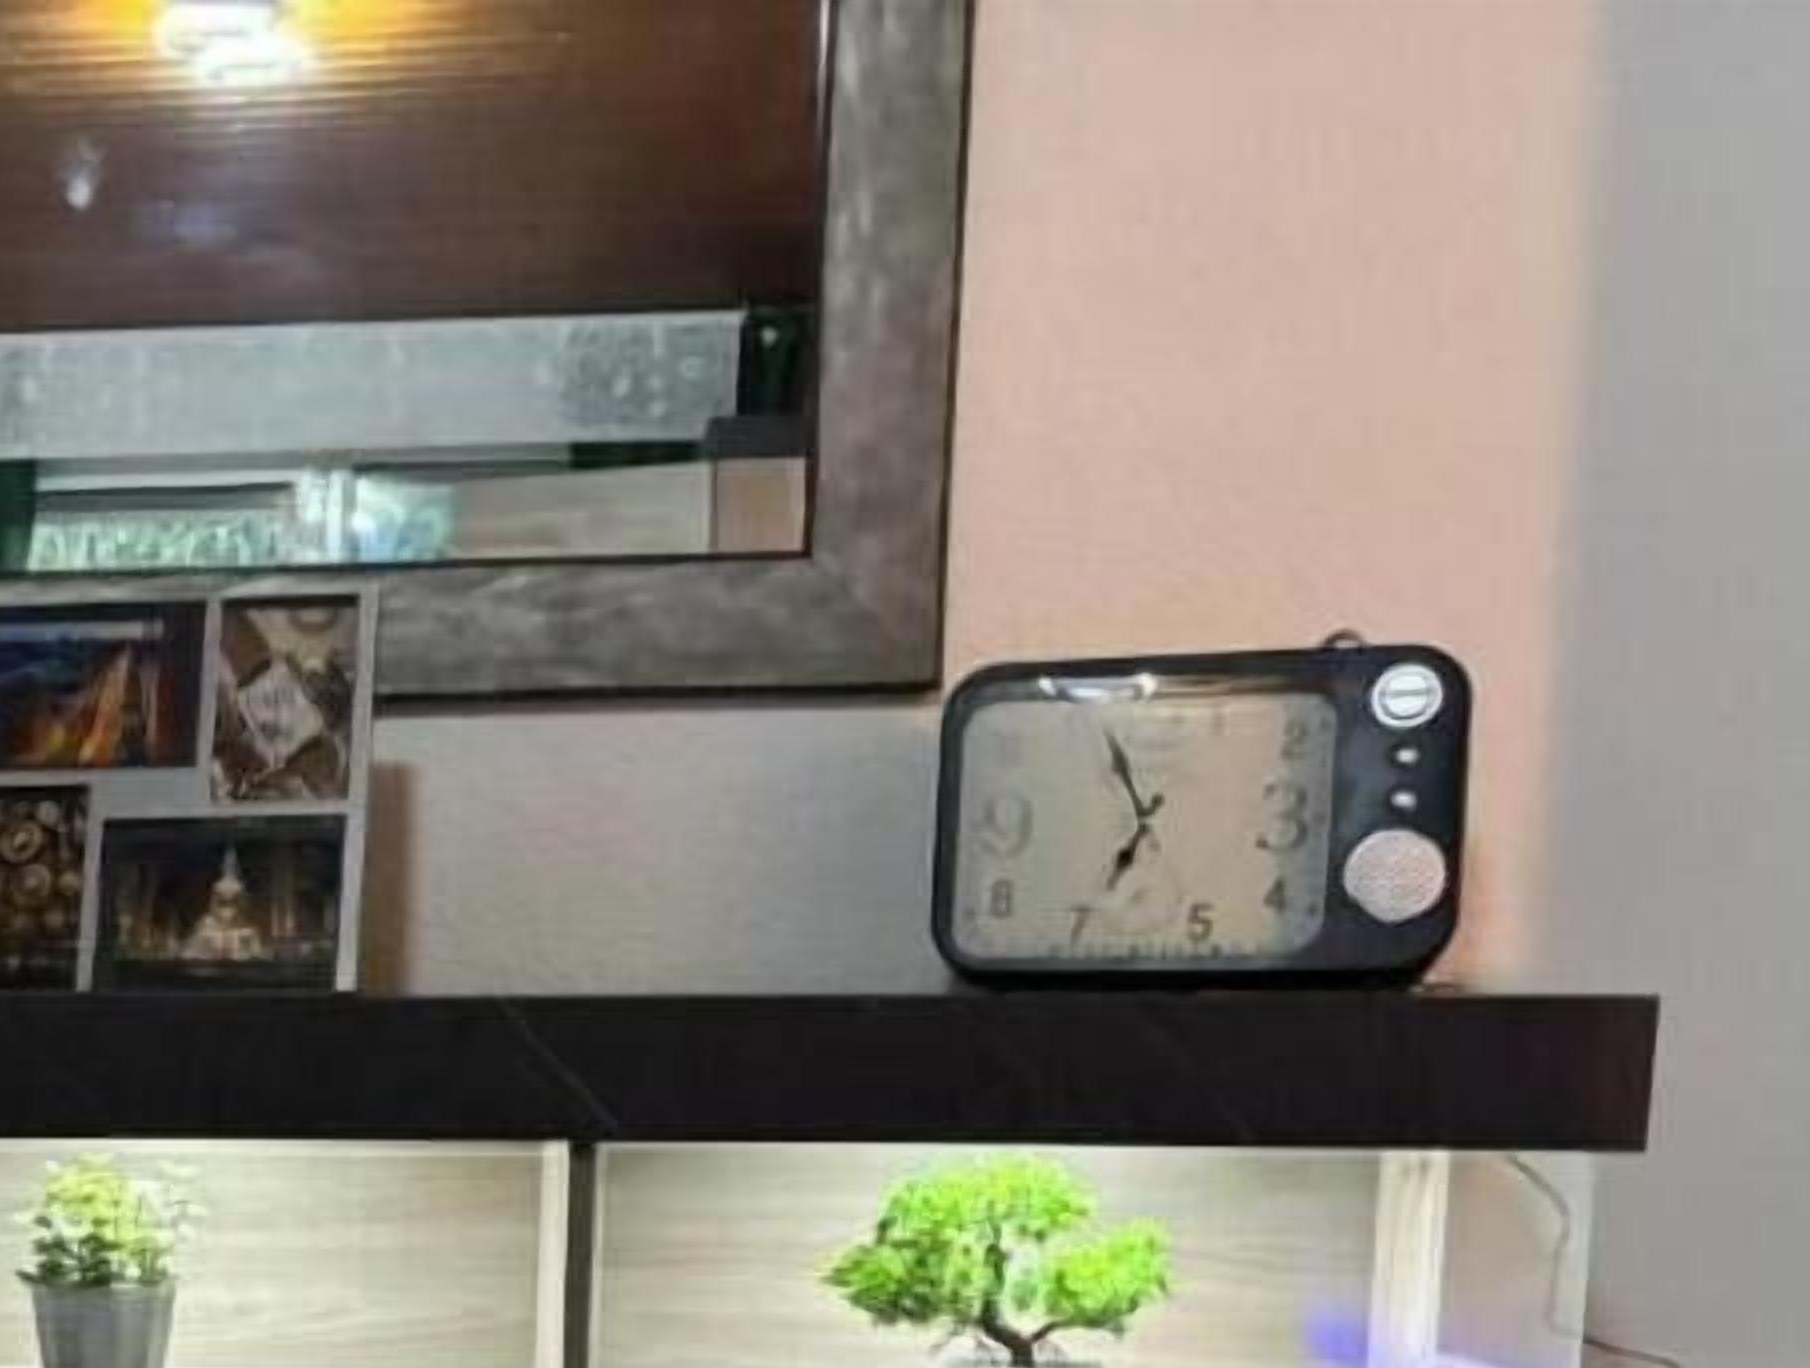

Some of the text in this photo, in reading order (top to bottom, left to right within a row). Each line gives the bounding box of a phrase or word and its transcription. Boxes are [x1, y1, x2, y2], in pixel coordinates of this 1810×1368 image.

[981, 792, 1034, 858] 9
[1256, 781, 1310, 853] 3
[989, 878, 1015, 919] 8
[1263, 875, 1289, 914] 4
[1068, 903, 1094, 946] 7
[1186, 900, 1216, 942] 5
